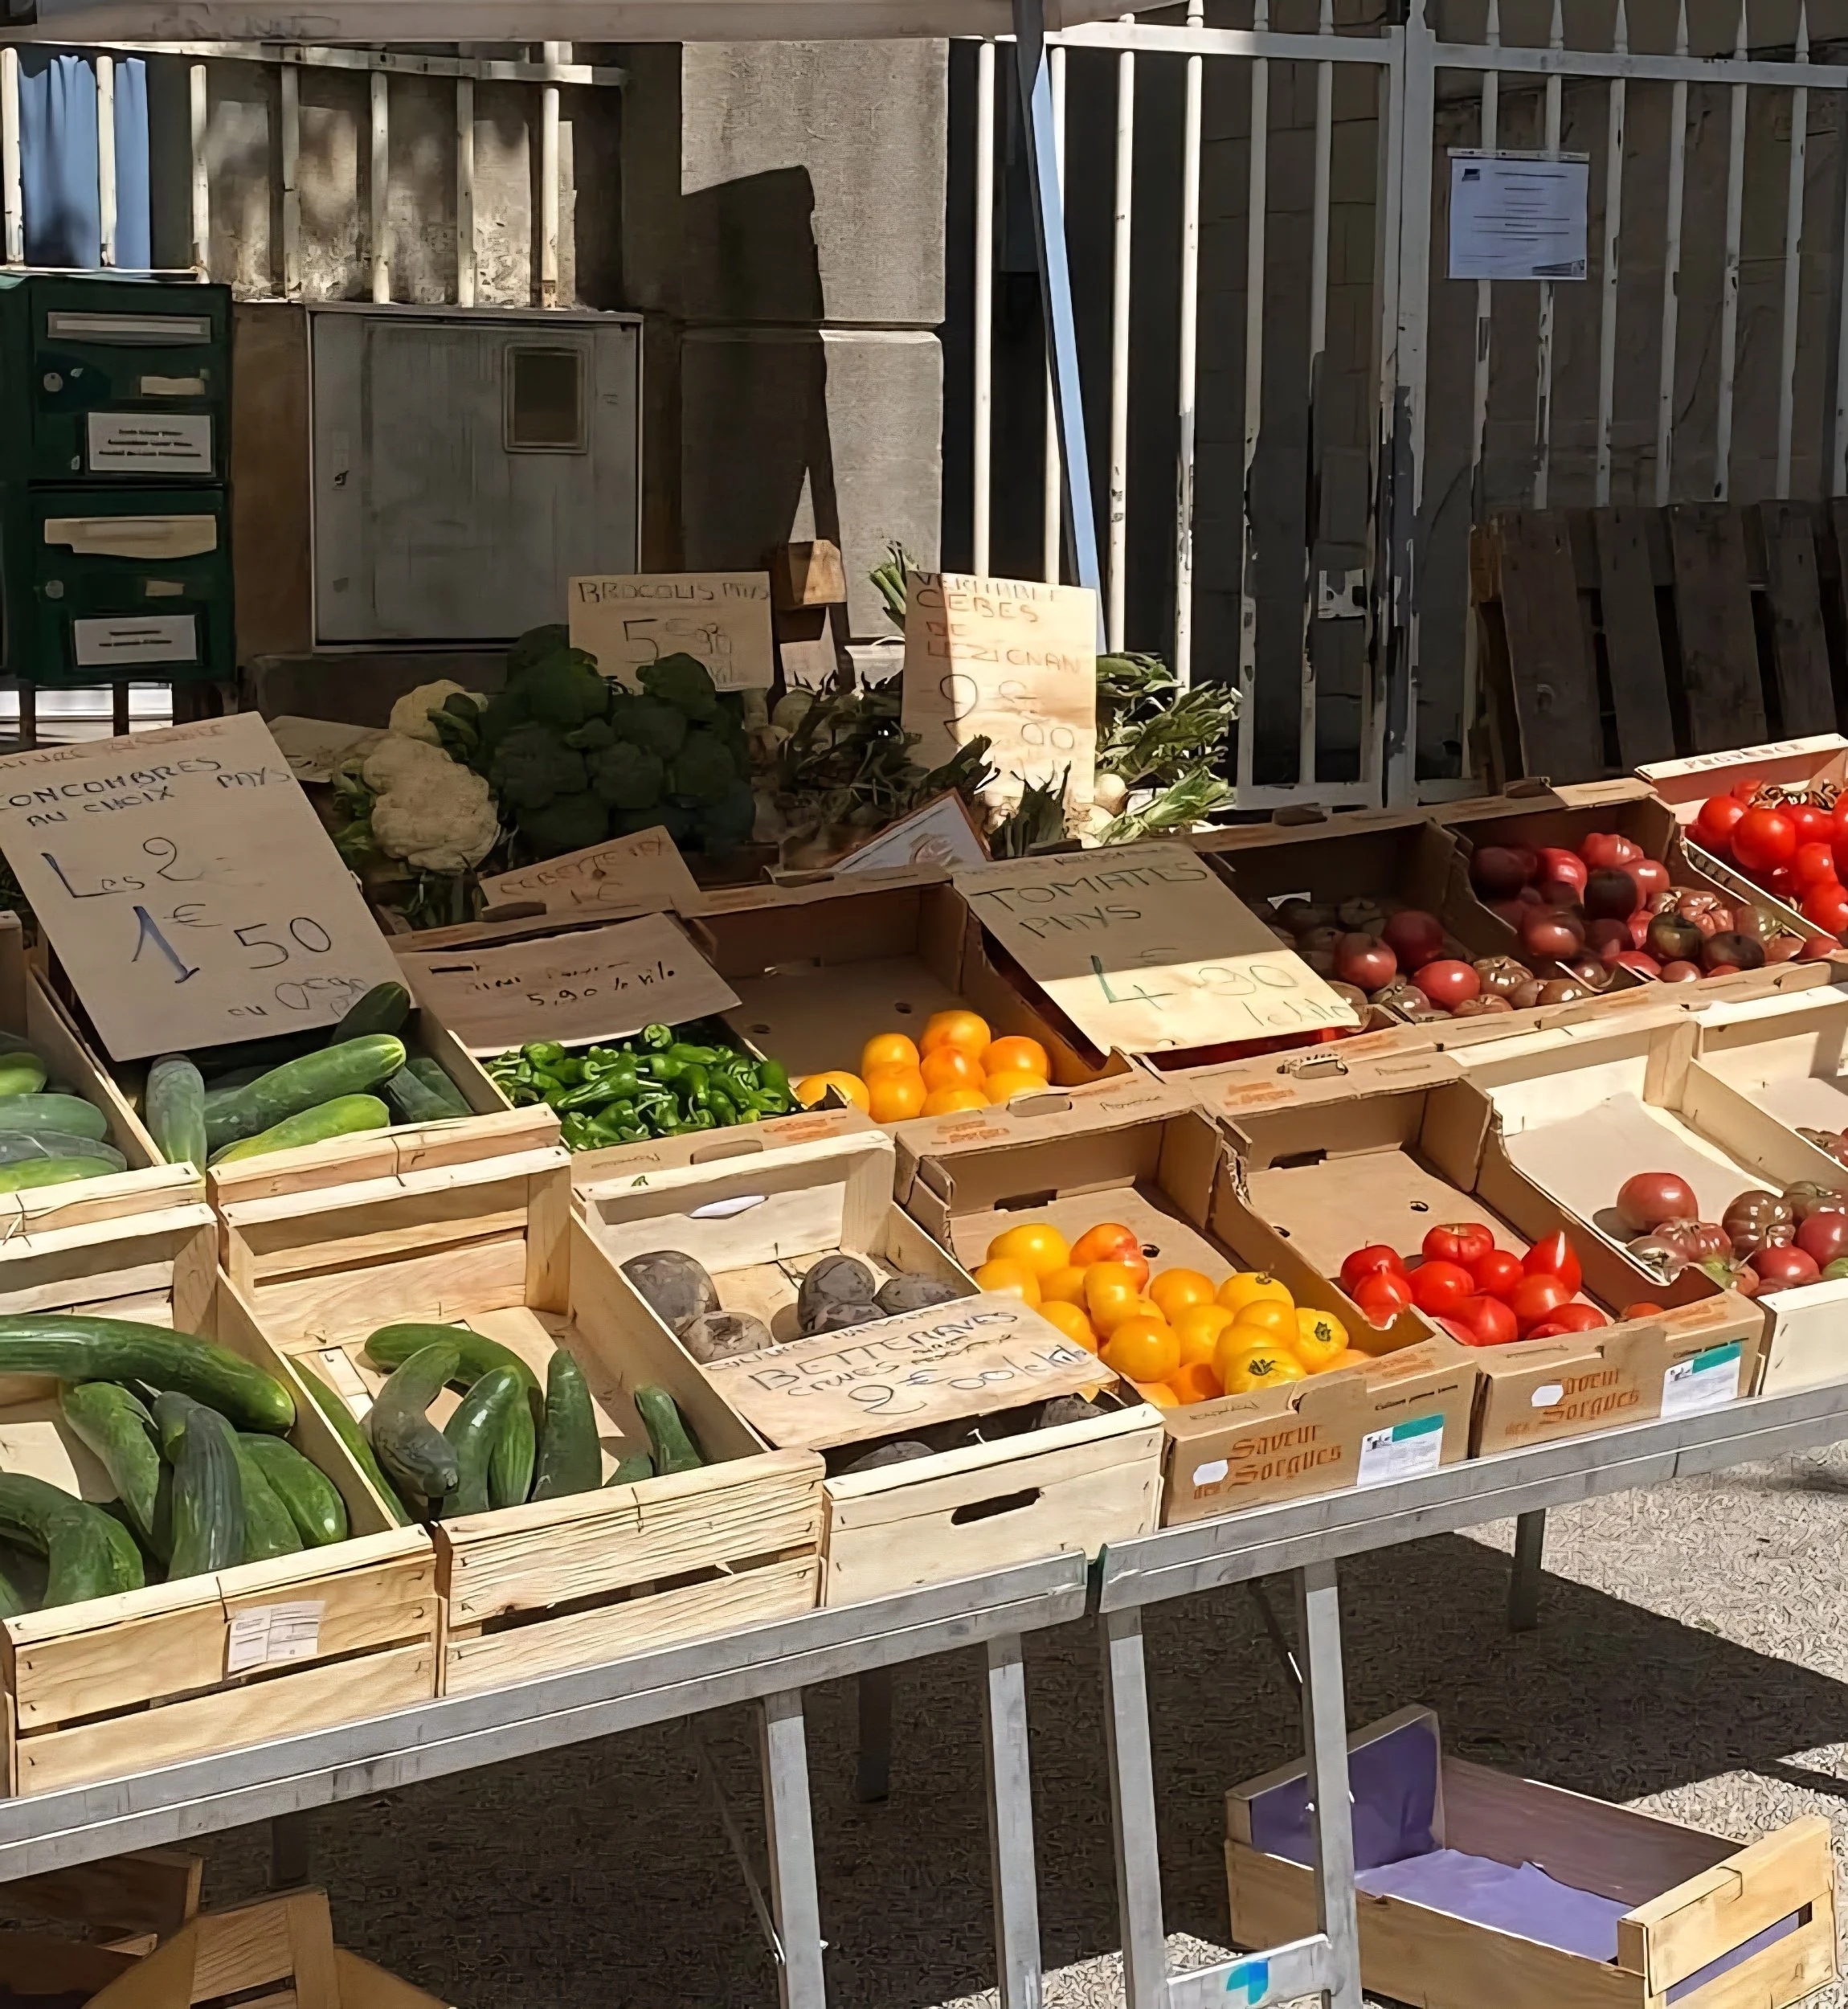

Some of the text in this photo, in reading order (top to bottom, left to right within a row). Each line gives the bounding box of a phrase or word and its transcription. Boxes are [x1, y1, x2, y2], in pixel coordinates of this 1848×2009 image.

[217, 767, 292, 788] PAYS
[27, 786, 175, 827] AU CHOIX
[142, 837, 204, 882] 2
[969, 861, 1208, 912] TOMATES
[1019, 904, 1142, 939] PAYS
[748, 1311, 1018, 1391] BETTERAVES
